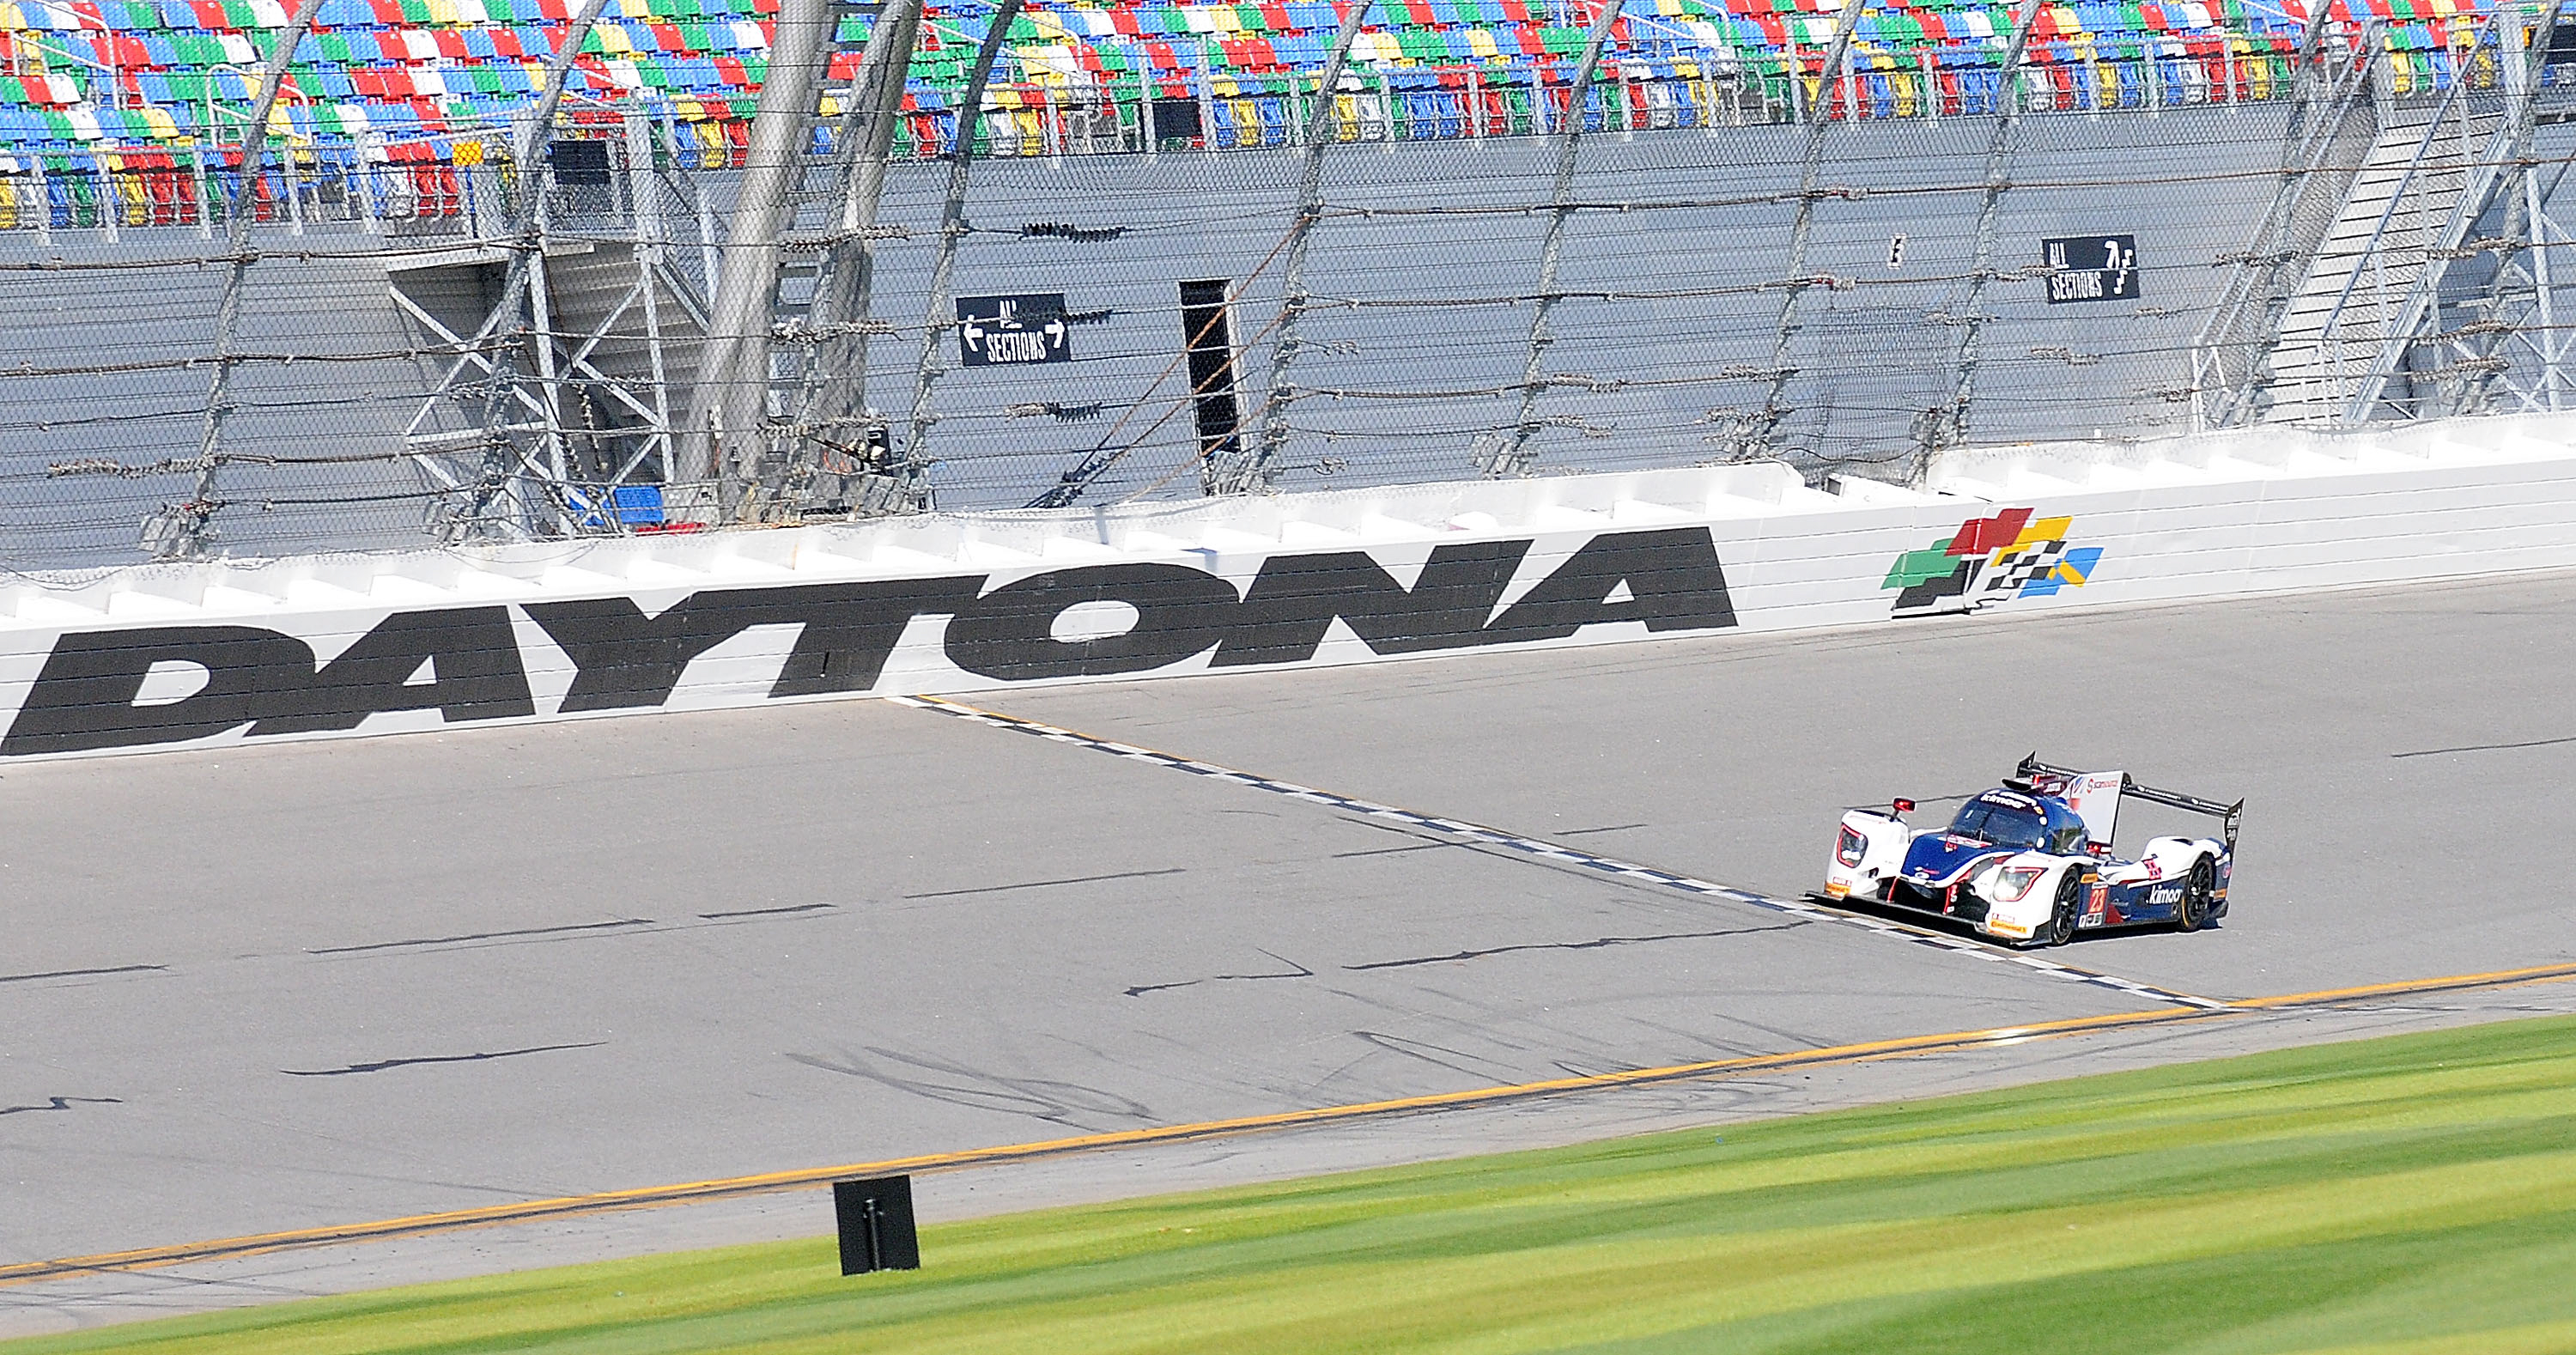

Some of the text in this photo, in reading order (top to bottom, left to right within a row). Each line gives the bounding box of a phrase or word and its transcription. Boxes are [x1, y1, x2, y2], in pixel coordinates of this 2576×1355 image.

[2050, 243, 2069, 269] ALL
[2051, 271, 2103, 301] SECTIONS
[986, 331, 1047, 362] SECTIONS
[0, 526, 1739, 756] DAYTONA
[2089, 889, 2105, 912] 23
